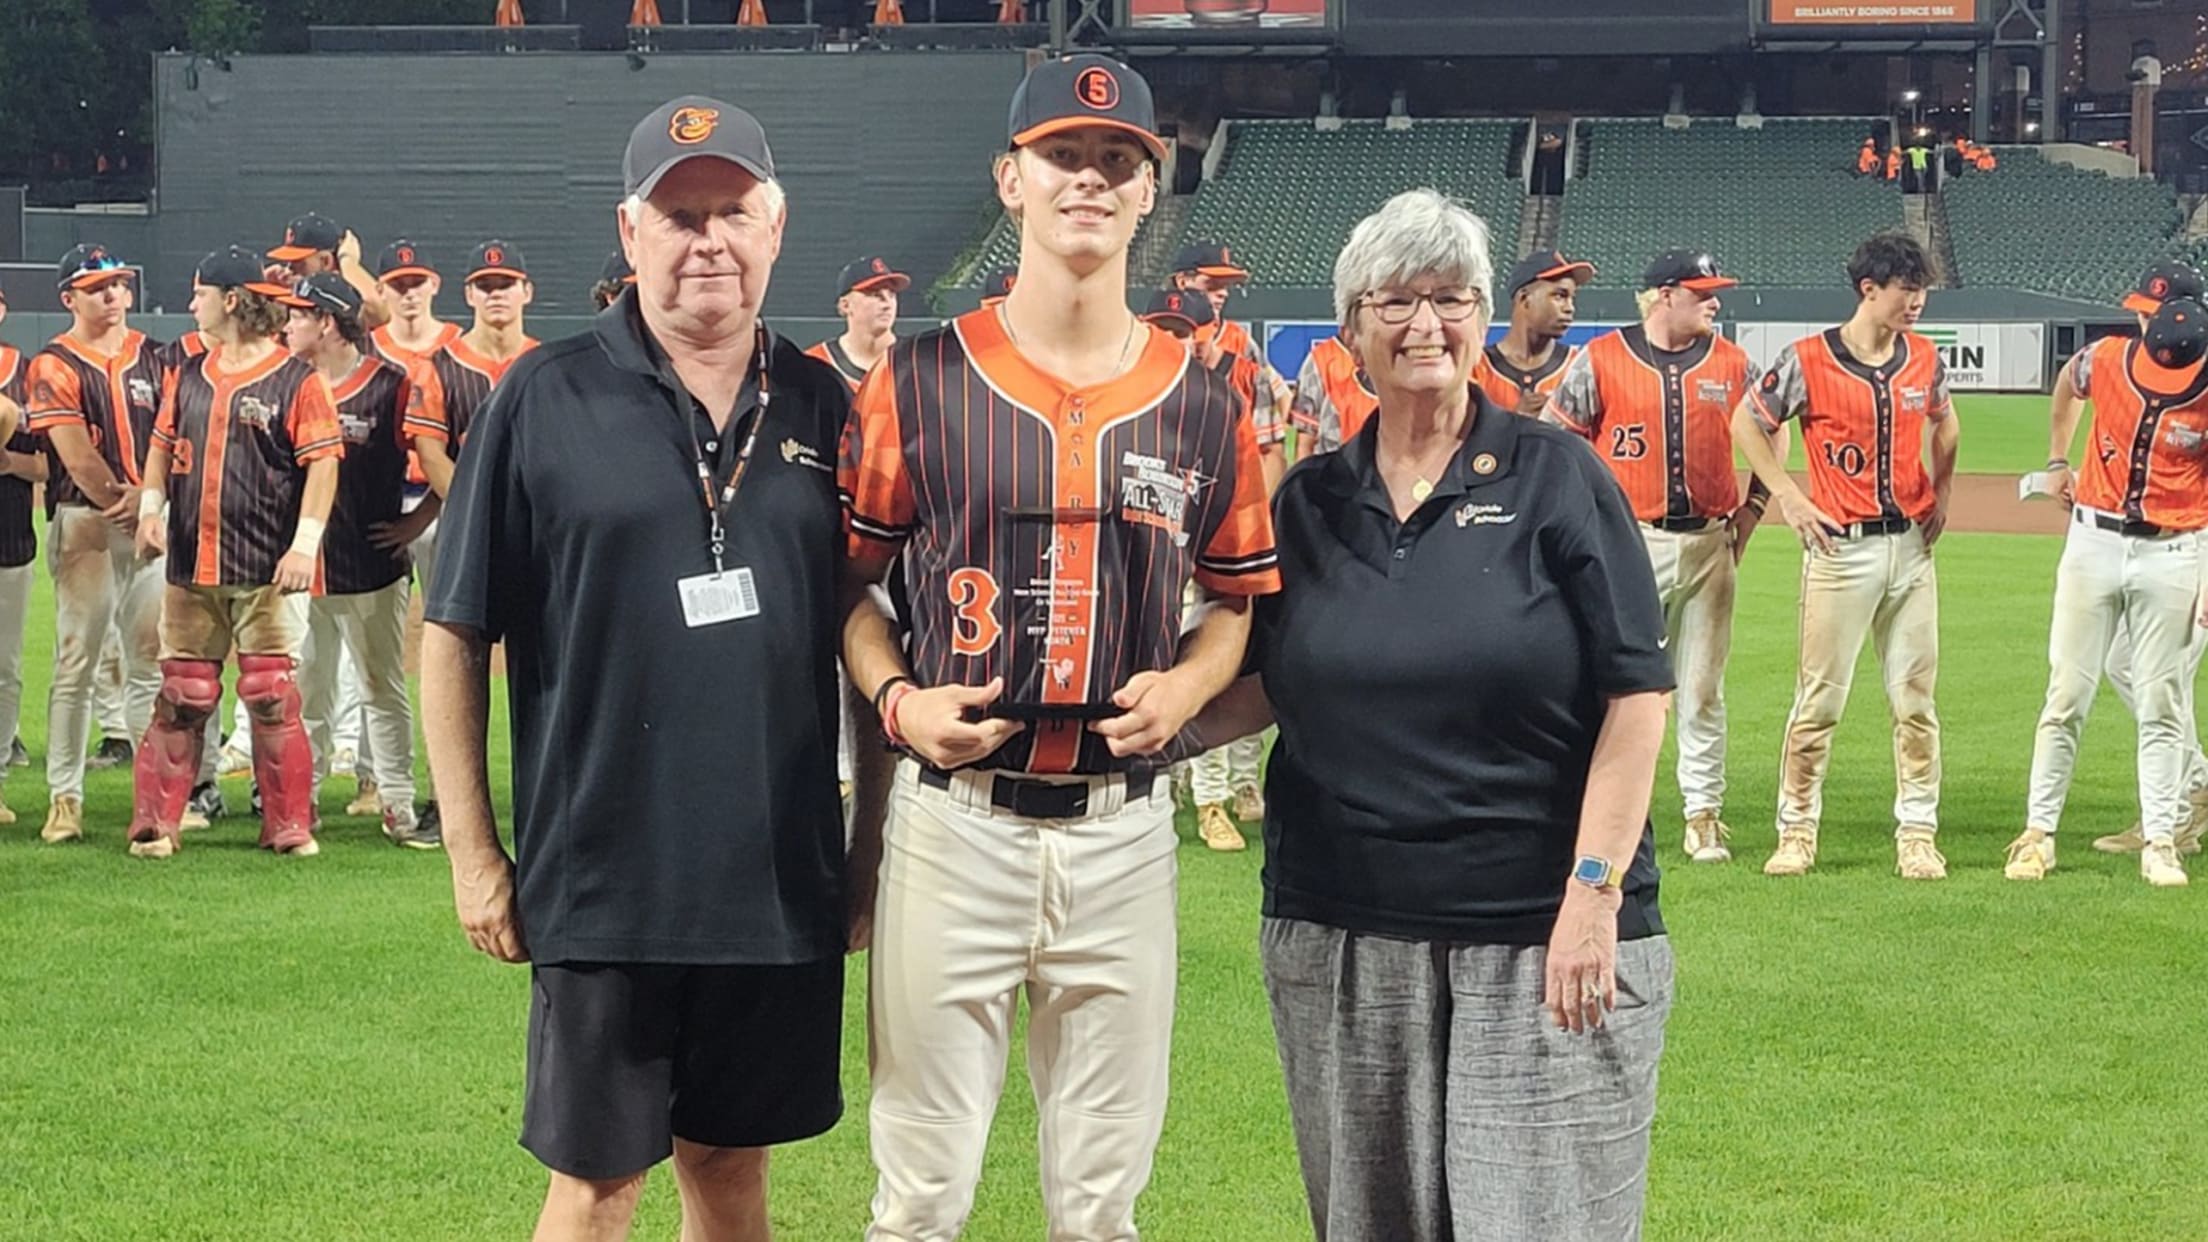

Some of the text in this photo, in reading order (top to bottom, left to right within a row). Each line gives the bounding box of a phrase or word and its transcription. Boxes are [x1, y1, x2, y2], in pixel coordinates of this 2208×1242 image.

[1795, 7, 1856, 17] BRILLIANTLY
[1857, 7, 1897, 16] BORING
[1900, 7, 1930, 16] SINCE
[1088, 73, 1107, 103] 5
[1611, 423, 1648, 460] 25
[1823, 438, 1868, 478] 10
[948, 567, 1002, 655] 3
